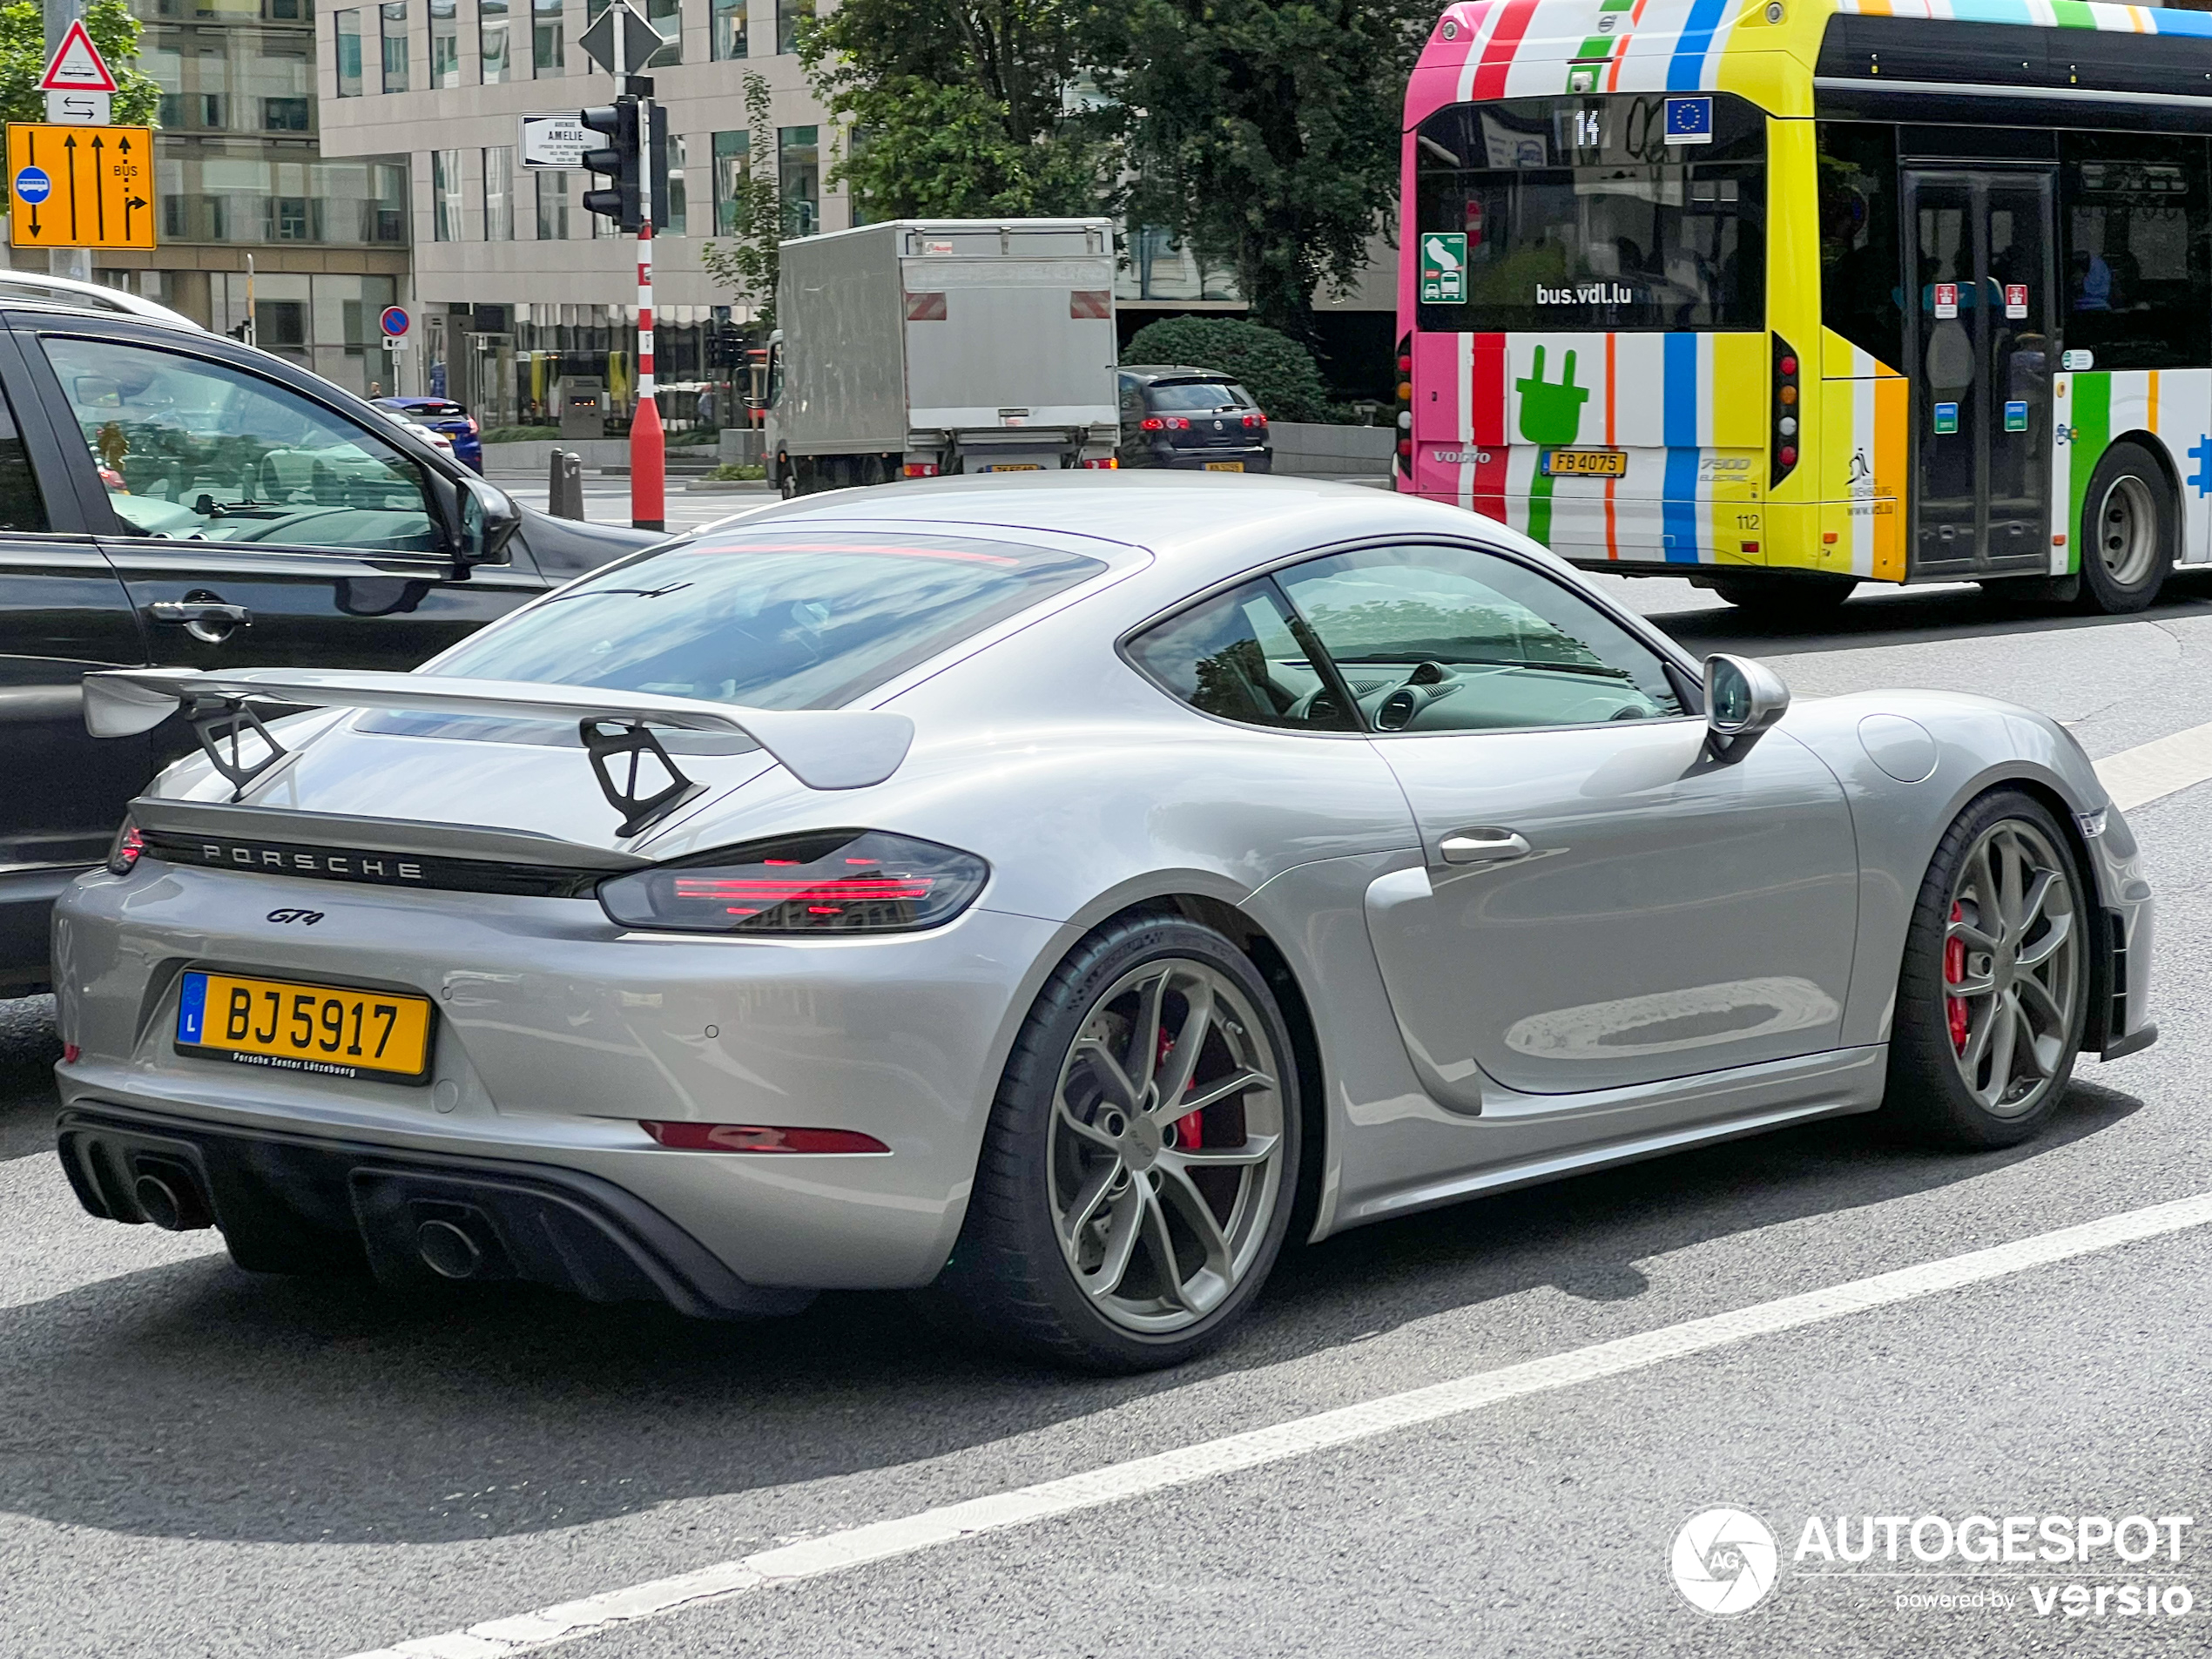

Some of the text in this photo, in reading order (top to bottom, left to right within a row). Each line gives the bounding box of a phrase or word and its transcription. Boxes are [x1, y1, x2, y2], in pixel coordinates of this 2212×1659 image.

[1575, 110, 1600, 145] 14
[547, 131, 584, 141] AMELIE
[113, 165, 138, 176] BUS
[1536, 282, 1632, 305] bus.vdl.lu
[1433, 450, 1492, 464] VOLVO
[1701, 459, 1750, 470] 7900
[1736, 514, 1760, 530] 112
[202, 845, 423, 880] PORSCHE
[266, 907, 326, 927] GT4
[185, 1013, 197, 1033] L
[233, 1051, 269, 1065] Porsche
